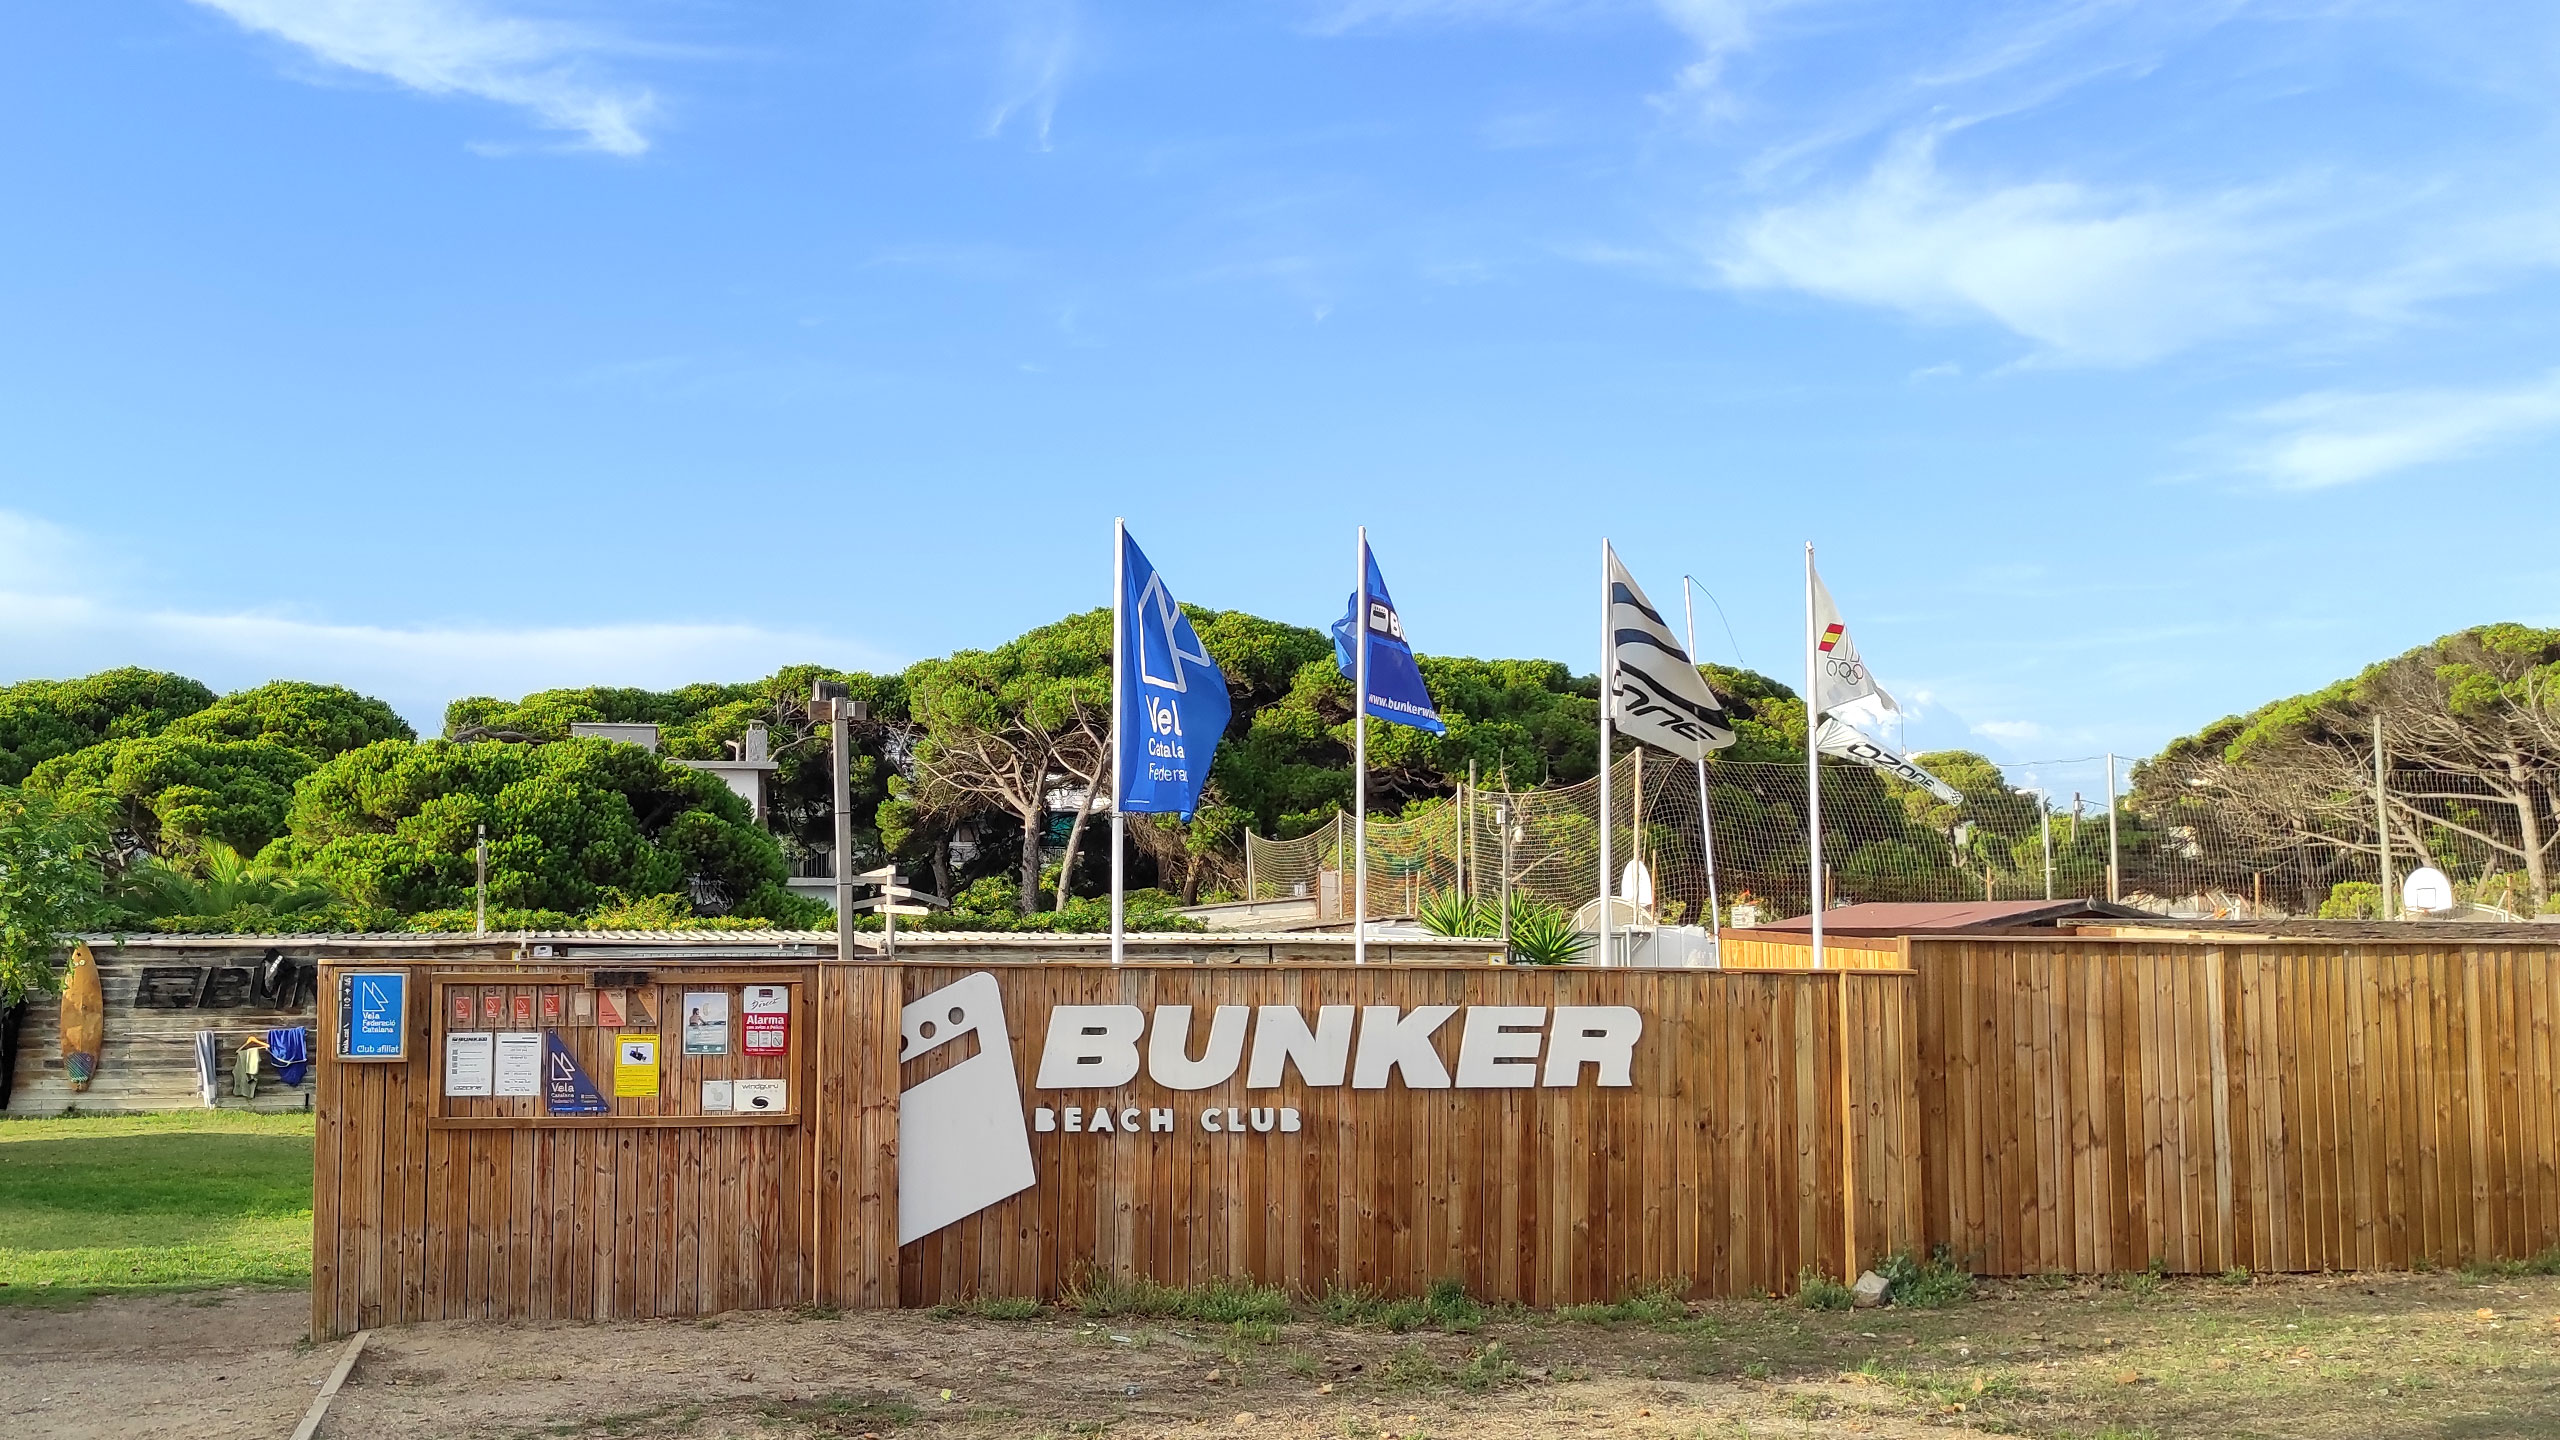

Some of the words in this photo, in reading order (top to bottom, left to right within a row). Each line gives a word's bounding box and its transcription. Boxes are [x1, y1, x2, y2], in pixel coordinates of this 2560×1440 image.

[362, 1011, 381, 1020] Vela
[746, 1014, 785, 1025] Alarma
[357, 1044, 375, 1053] Club
[1036, 1005, 1642, 1090] BUNKER
[551, 1082, 575, 1093] Vela
[1035, 1107, 1175, 1133] BEACH
[1200, 1107, 1302, 1133] CLUB
